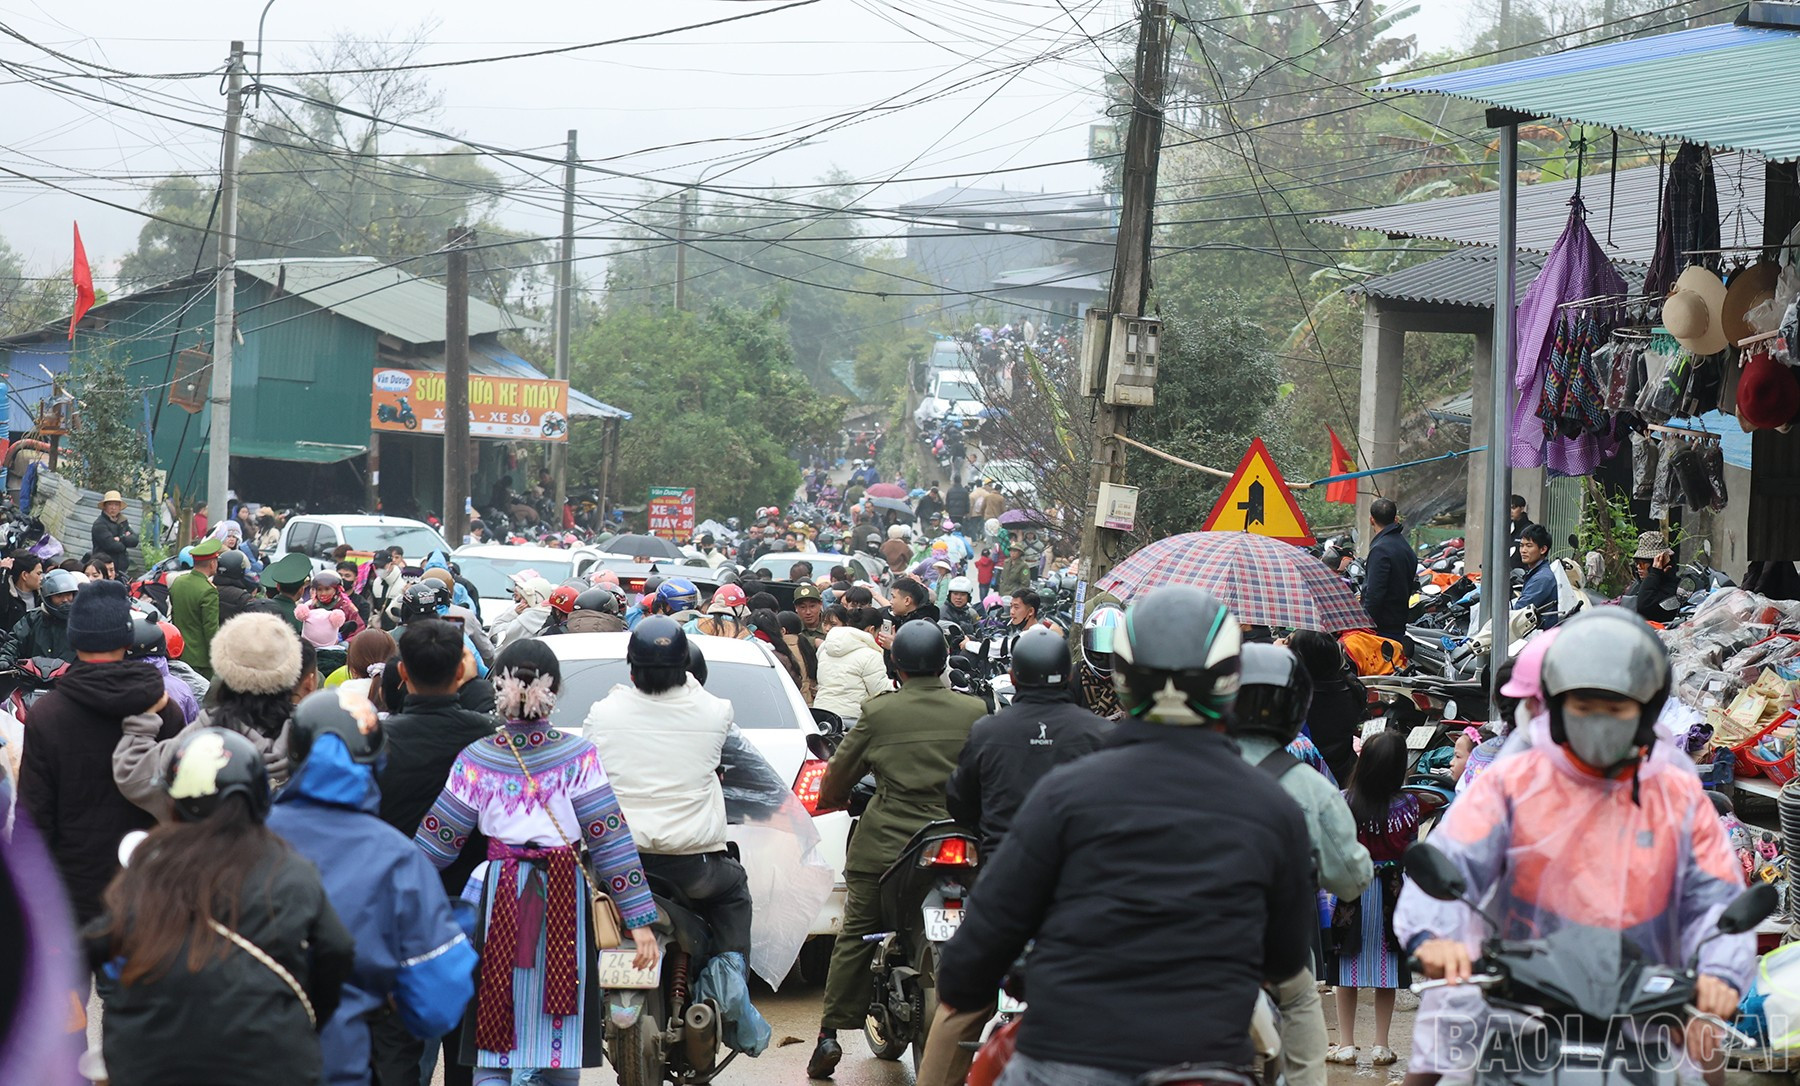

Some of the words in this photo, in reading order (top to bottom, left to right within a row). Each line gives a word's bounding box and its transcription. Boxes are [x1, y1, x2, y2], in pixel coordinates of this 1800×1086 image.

[416, 374, 446, 401] SỬA
[499, 383, 519, 407] XE
[523, 383, 560, 408] MÁY
[489, 411, 507, 423] XE
[512, 409, 530, 425] SỐ
[652, 505, 667, 515] XE
[651, 517, 678, 528] MÁY
[600, 969, 656, 985] 485.29
